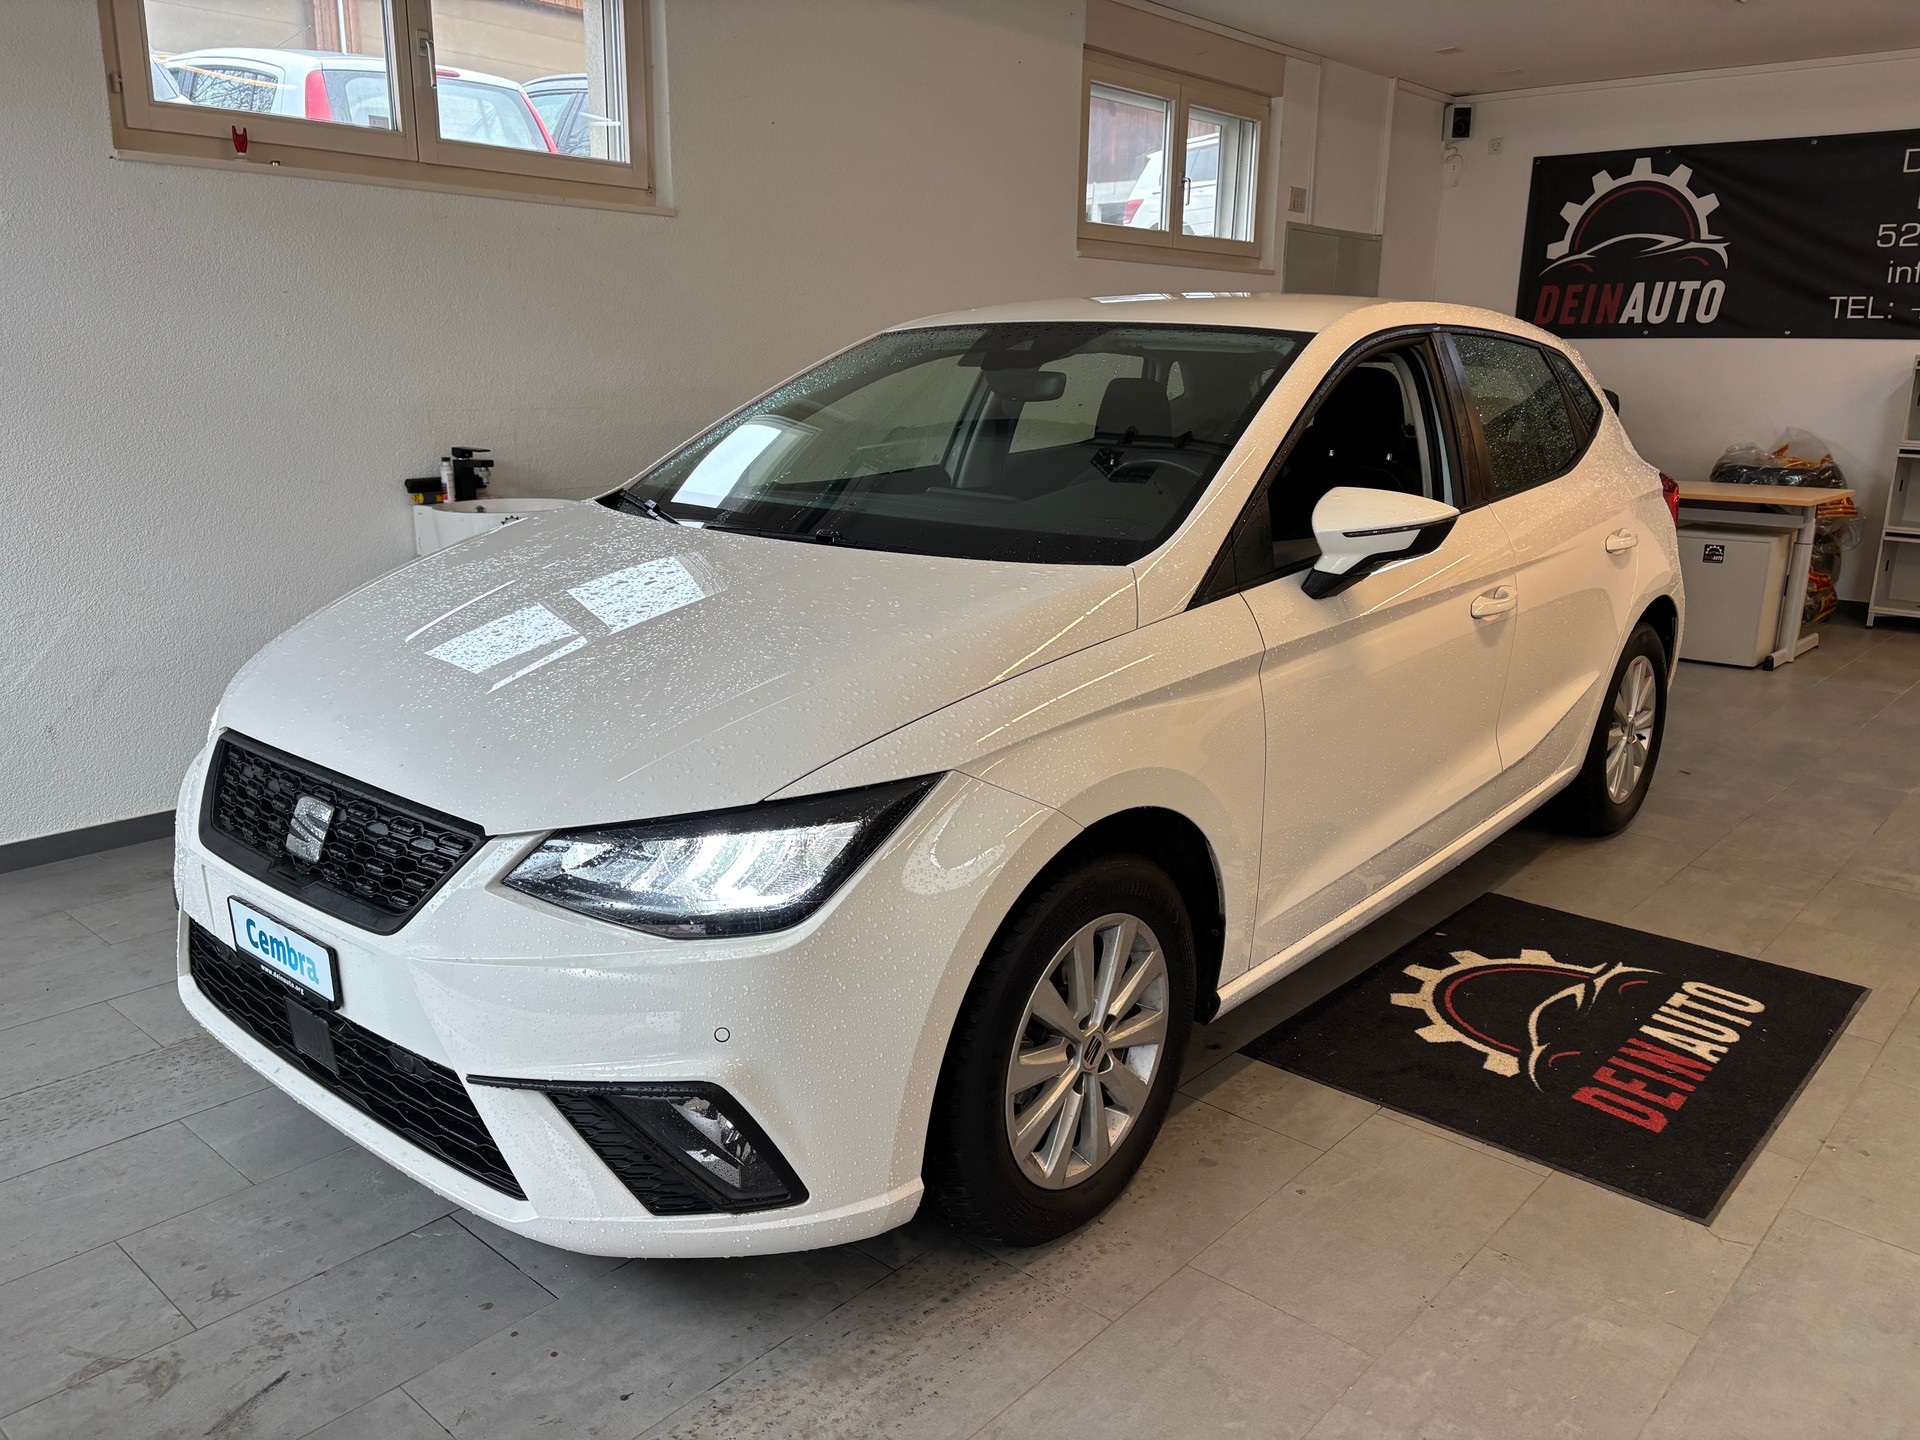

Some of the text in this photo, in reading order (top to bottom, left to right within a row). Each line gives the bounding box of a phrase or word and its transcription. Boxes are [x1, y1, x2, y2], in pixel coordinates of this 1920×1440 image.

[1876, 223, 1920, 247] 52
[1534, 279, 1726, 325] DEINAUTO
[1829, 296, 1894, 319] TEL:
[246, 918, 319, 985] Cembra
[1572, 981, 1766, 1134] DEINAUTO
